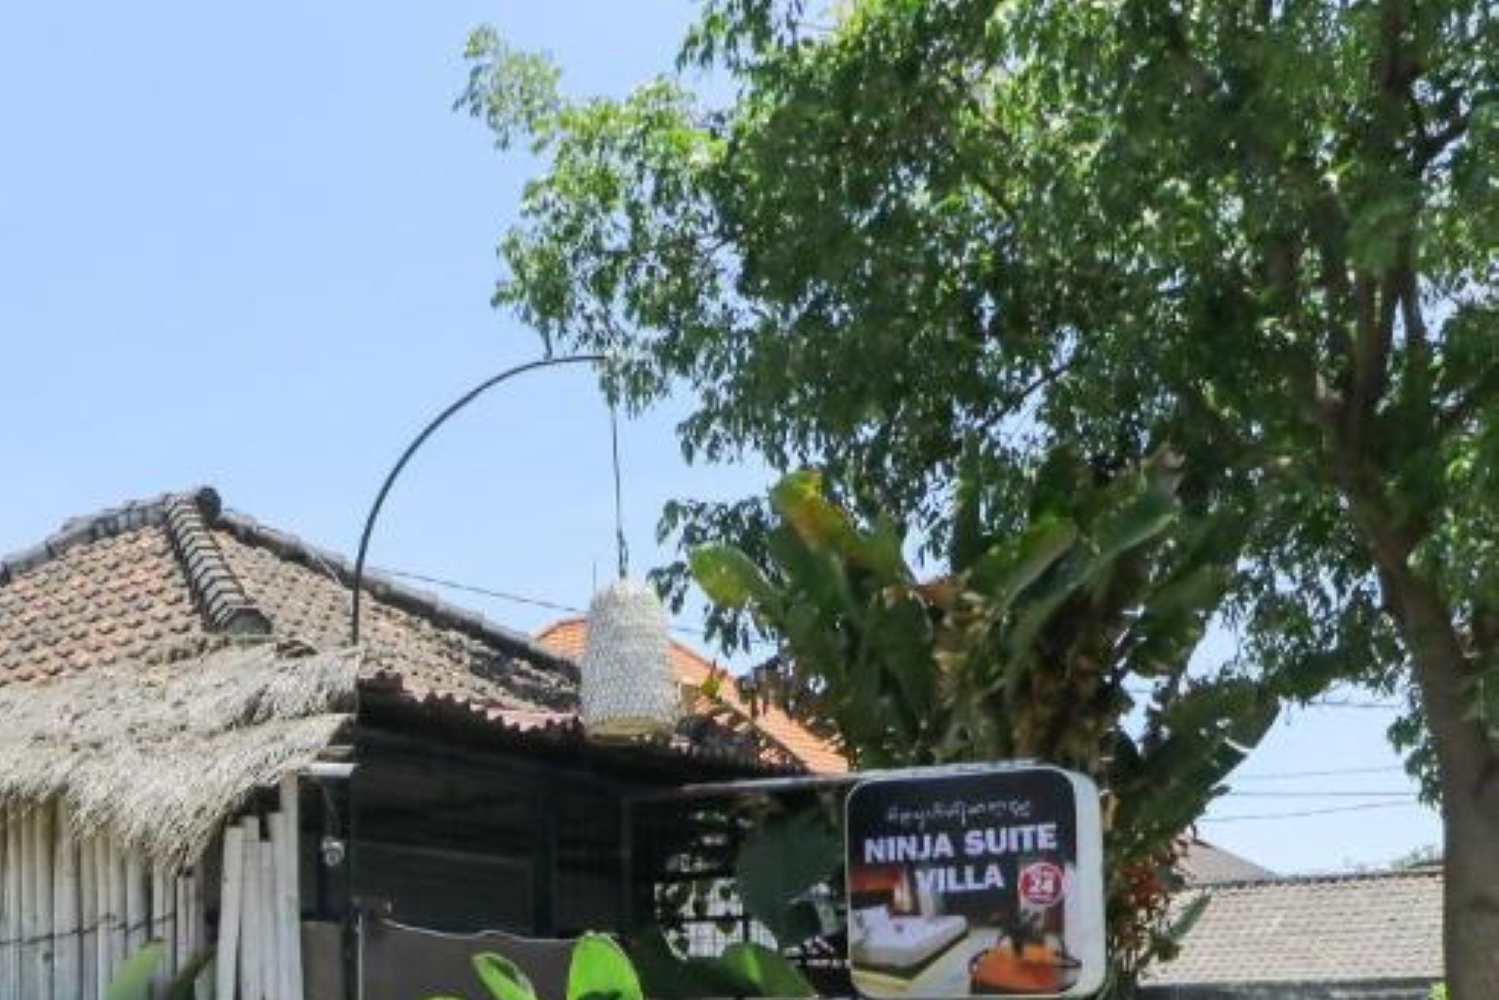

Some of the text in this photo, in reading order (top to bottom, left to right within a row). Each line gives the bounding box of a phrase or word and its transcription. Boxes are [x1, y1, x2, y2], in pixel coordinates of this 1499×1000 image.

[864, 822, 1057, 863] NINJA SUITE
[915, 863, 1004, 892] VILLA
